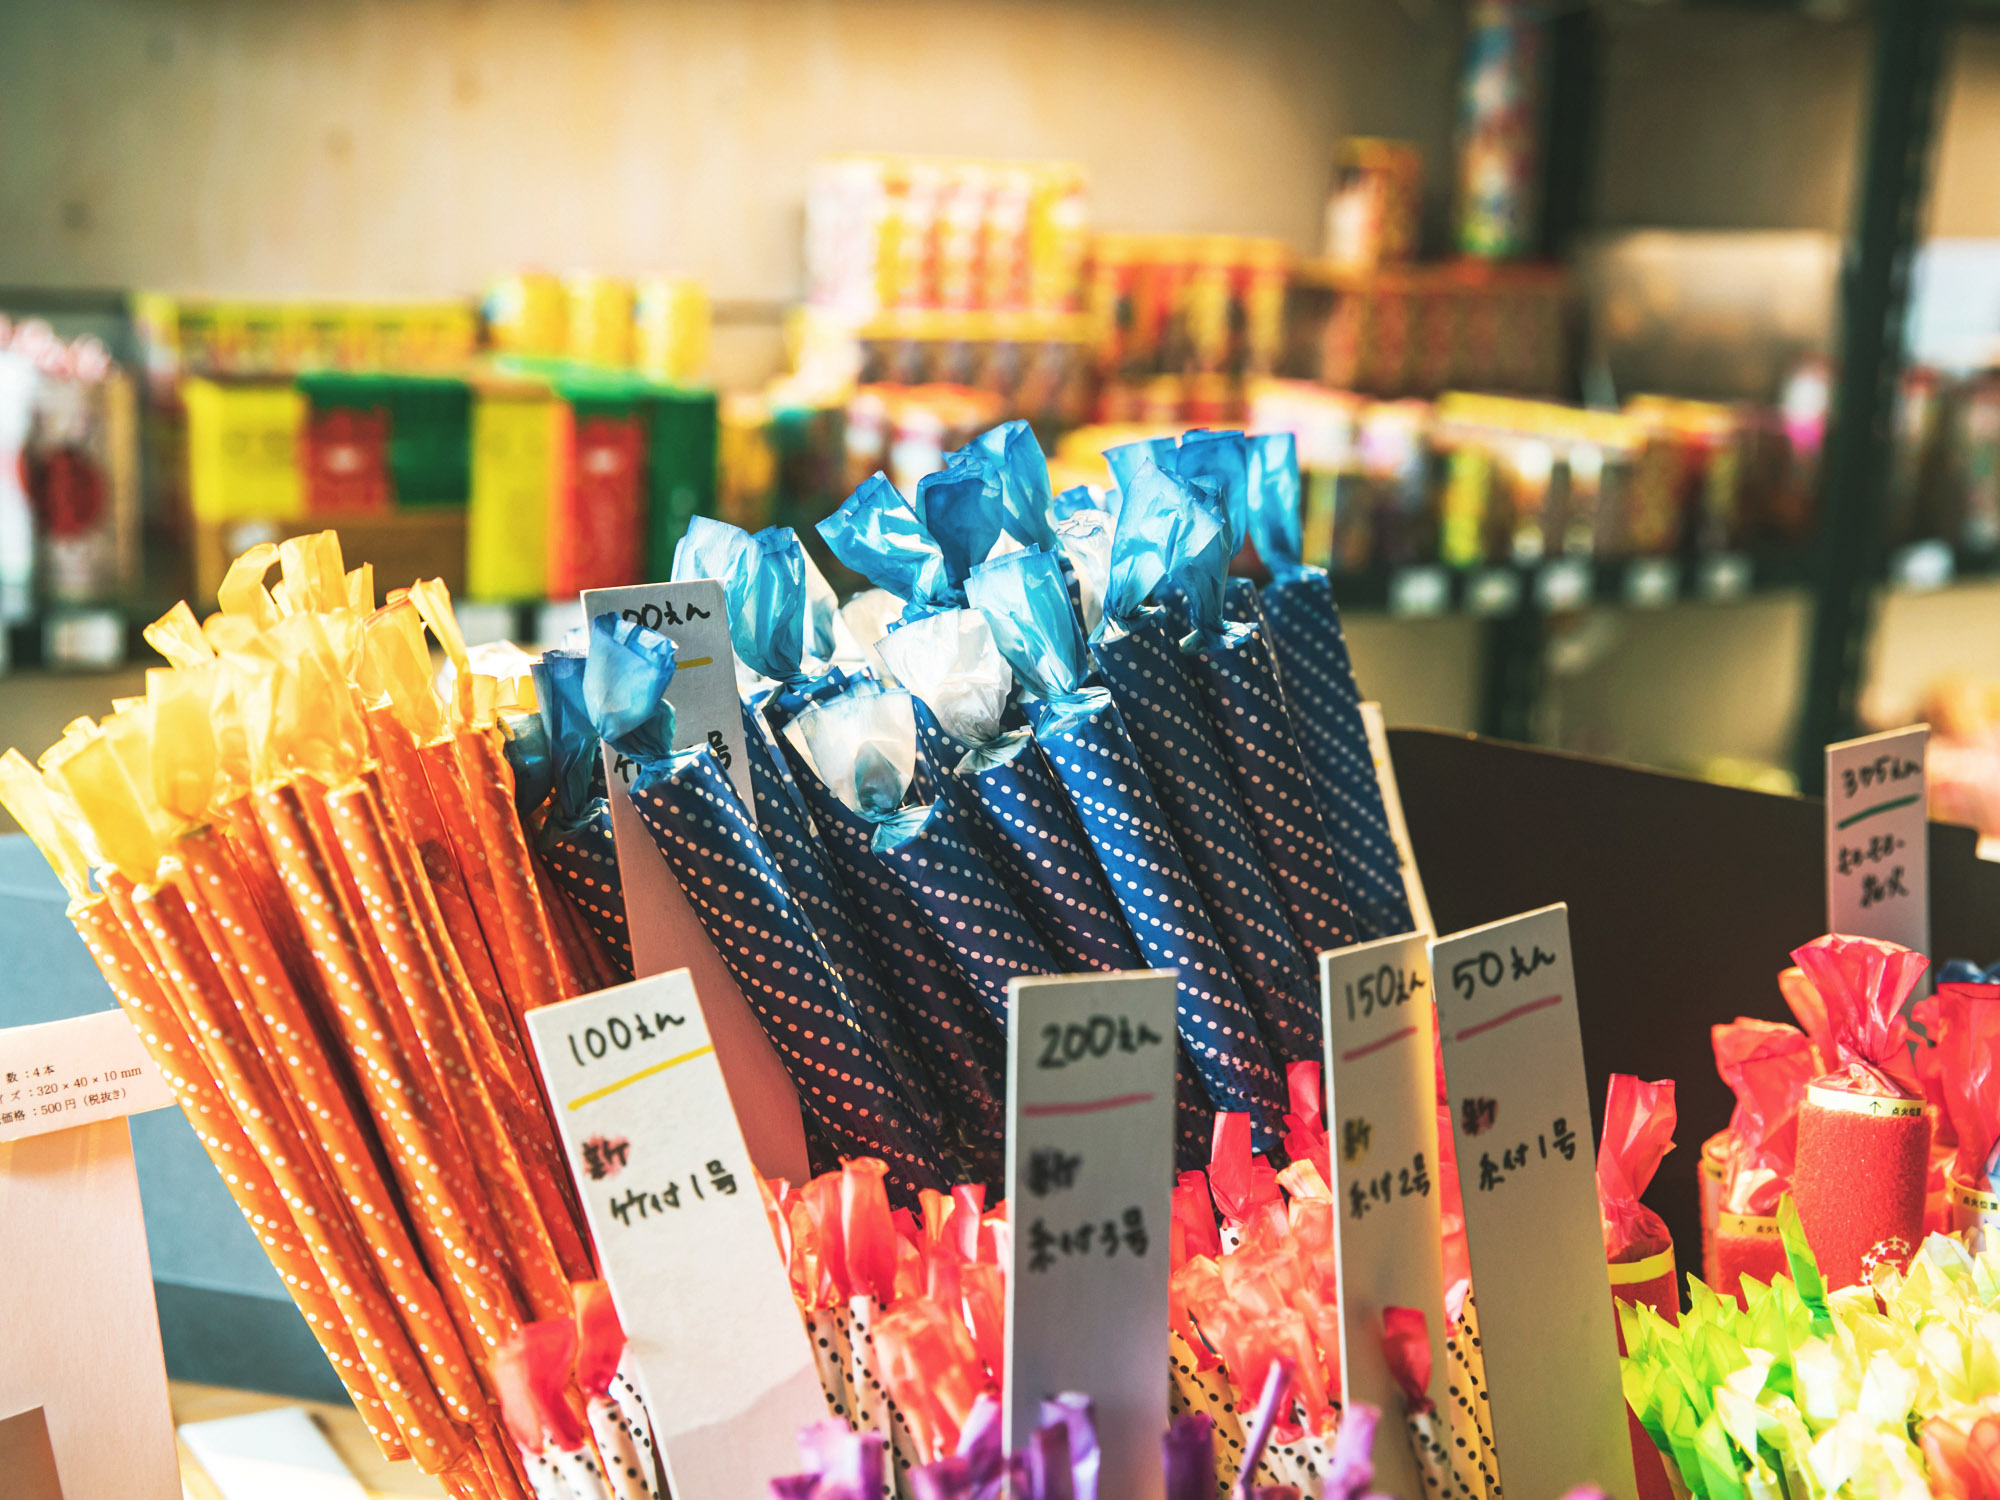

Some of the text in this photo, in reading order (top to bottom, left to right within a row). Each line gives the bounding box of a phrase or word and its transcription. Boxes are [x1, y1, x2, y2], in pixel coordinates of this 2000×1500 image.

[622, 600, 711, 632] 00えん
[1345, 964, 1425, 1021] 150えん
[1452, 946, 1555, 1000] 50えん
[568, 1012, 686, 1067] 100えん
[1036, 1014, 1162, 1070] 200えん
